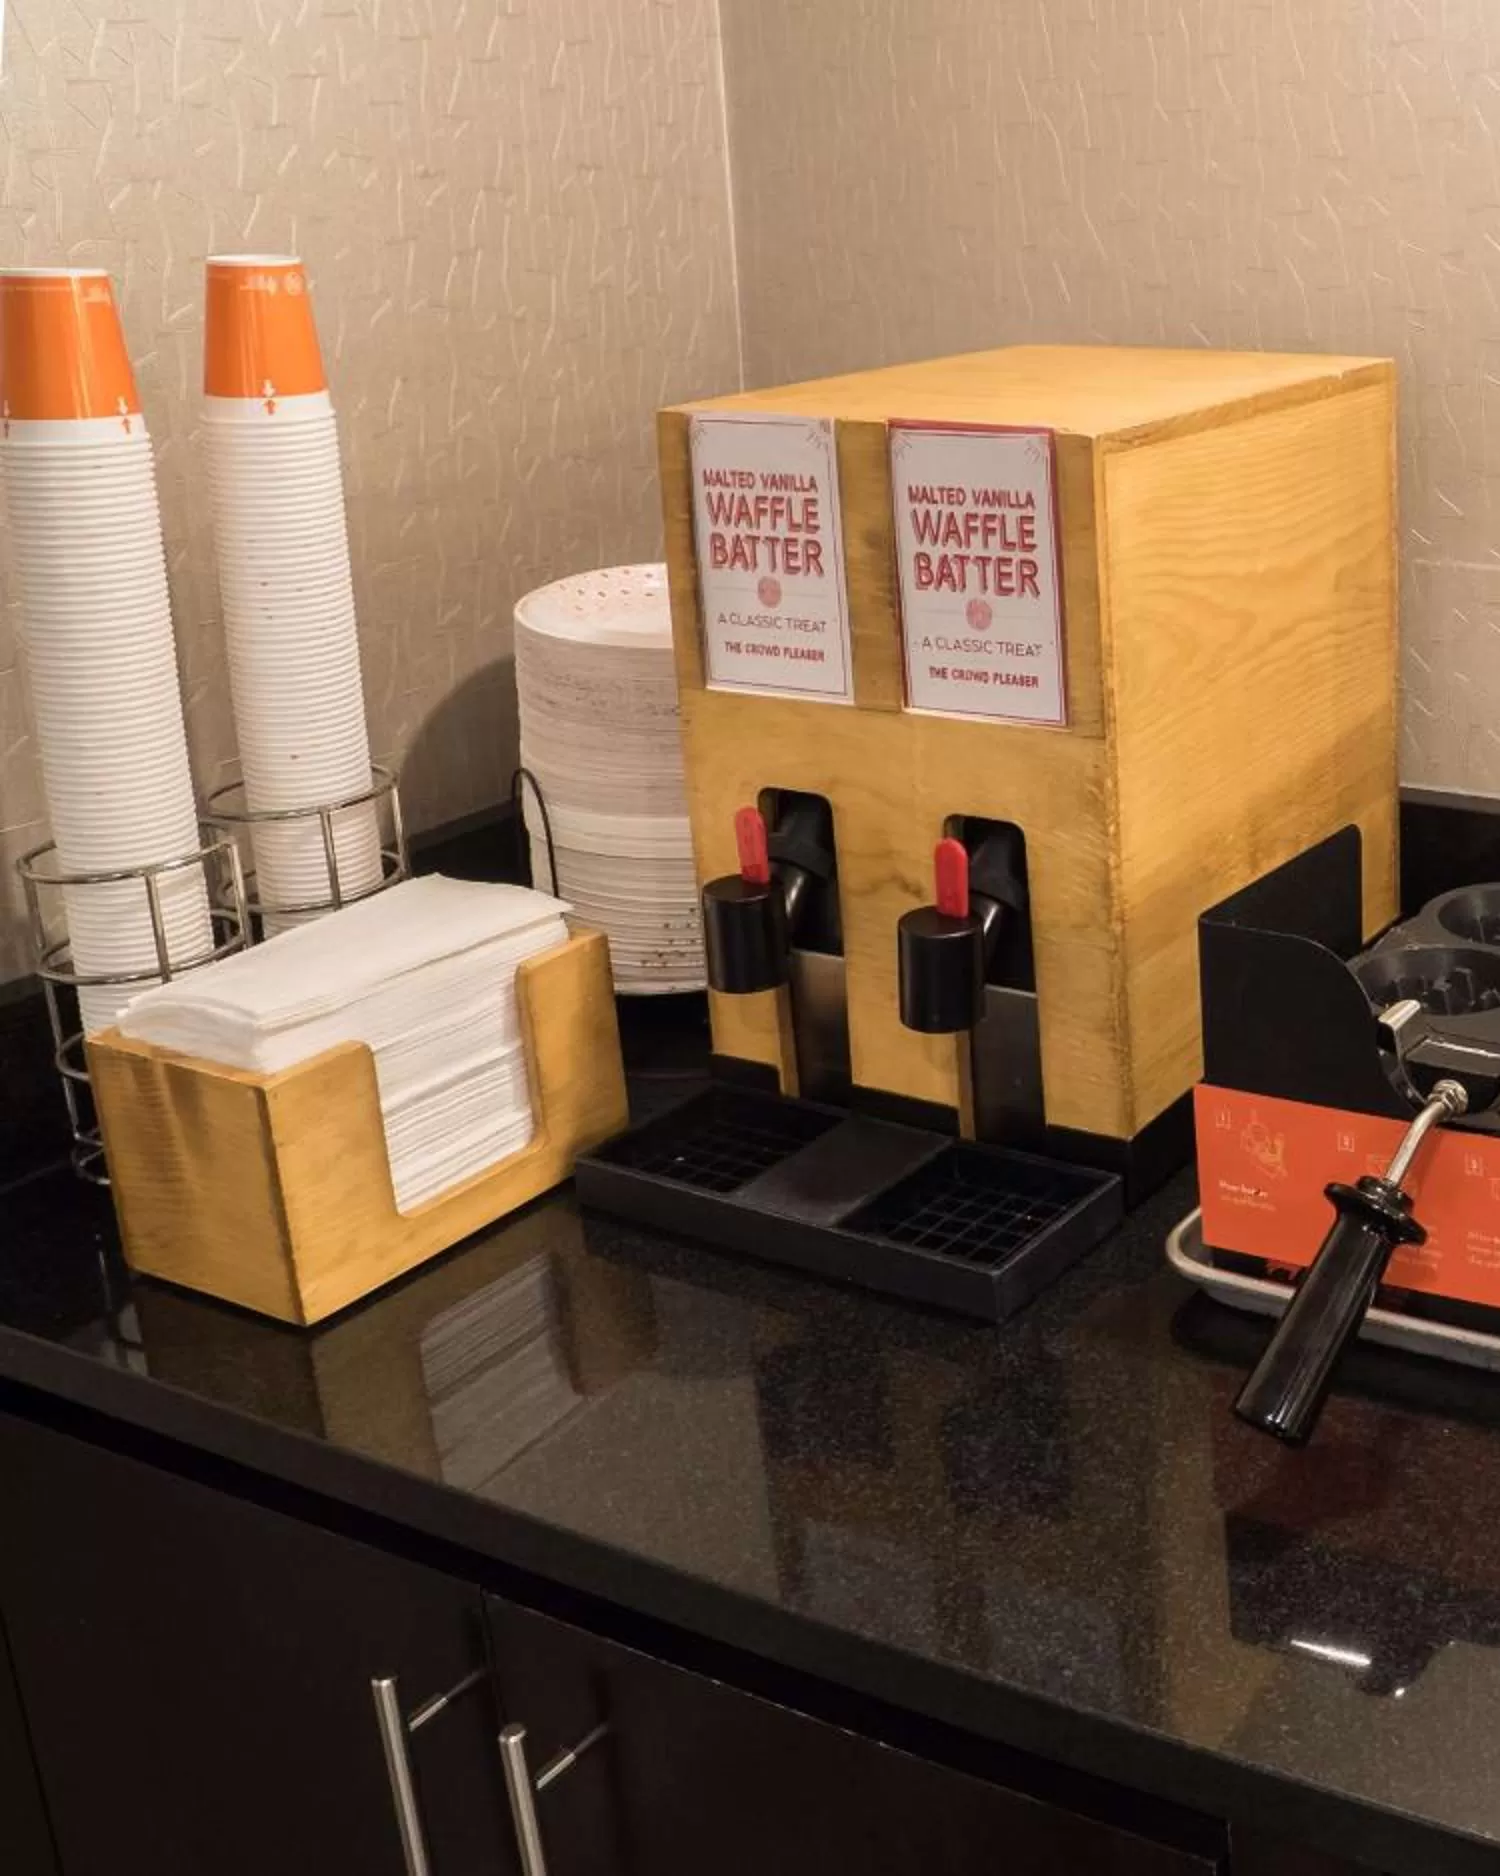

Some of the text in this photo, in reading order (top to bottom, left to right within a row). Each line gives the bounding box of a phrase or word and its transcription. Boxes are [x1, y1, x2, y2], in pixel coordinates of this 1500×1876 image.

[702, 468, 818, 492] MALTED VANILLA
[908, 484, 1035, 510] MALTED VANILLA
[706, 491, 821, 534] WAFFLE
[911, 508, 1037, 552] WAFFLE
[710, 532, 824, 577] BATTER
[914, 551, 1040, 598] BATTER
[718, 612, 827, 633] A CLASSIC TREAT
[725, 641, 742, 654] THE
[744, 643, 780, 657] CROWD
[922, 635, 1042, 657] A CLASSIC TREAT
[929, 665, 1039, 688] THE CROWD PLEASER
